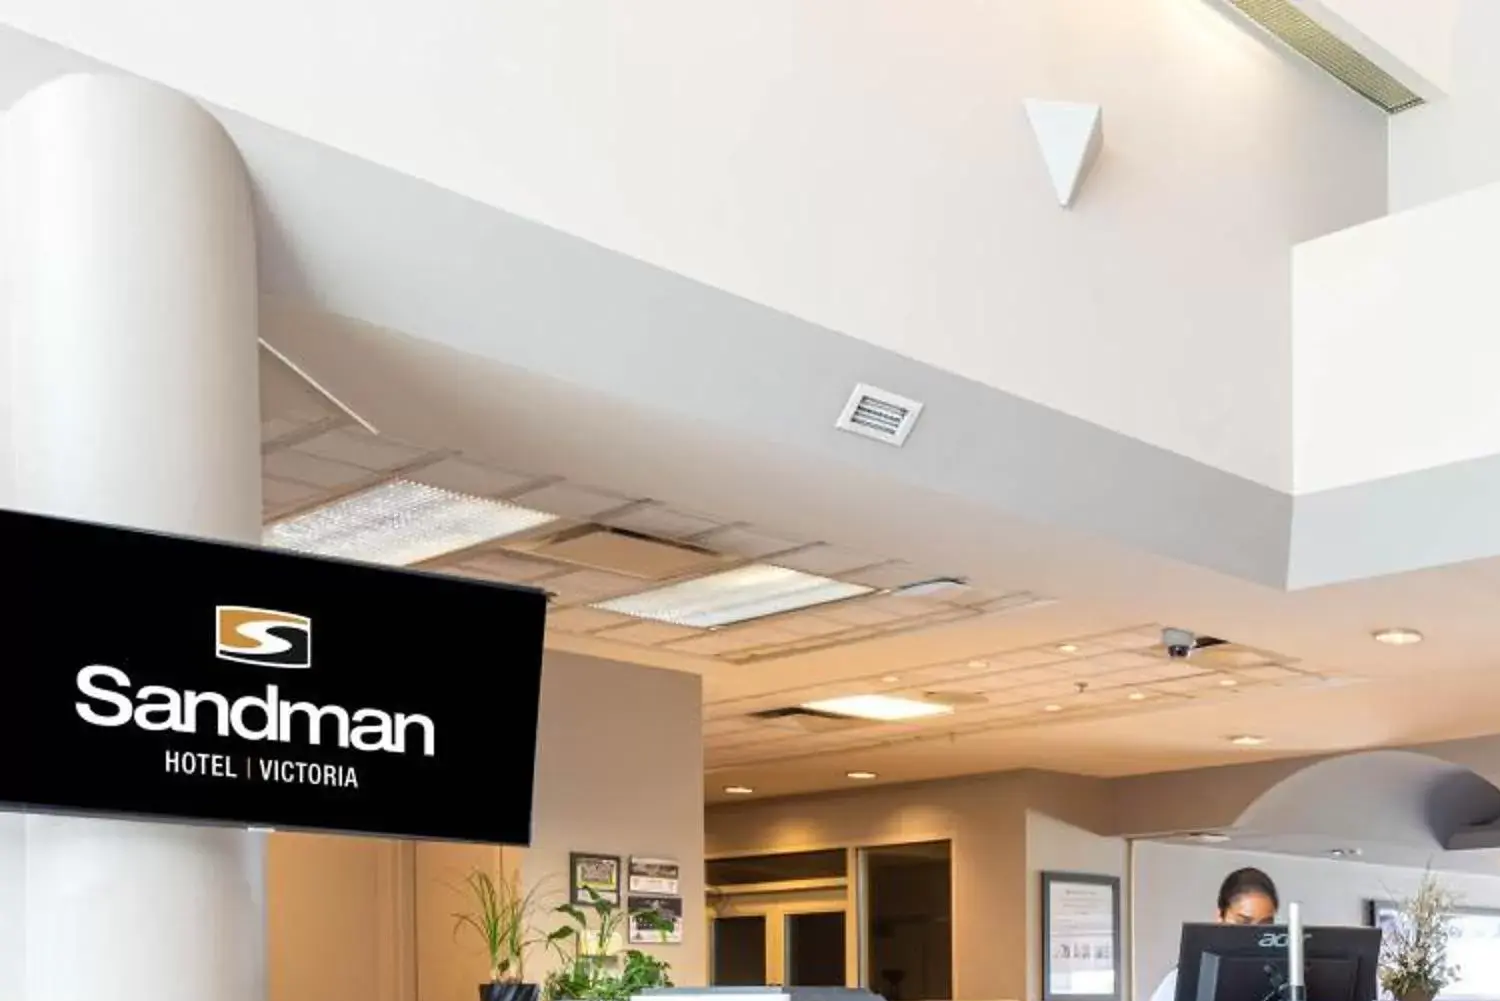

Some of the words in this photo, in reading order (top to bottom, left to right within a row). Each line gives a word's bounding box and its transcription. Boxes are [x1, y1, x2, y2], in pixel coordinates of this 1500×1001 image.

[76, 665, 435, 756] Sandman
[165, 749, 238, 778] HOTEL
[259, 757, 359, 788] VICTORIA
[1258, 932, 1313, 947] ac
